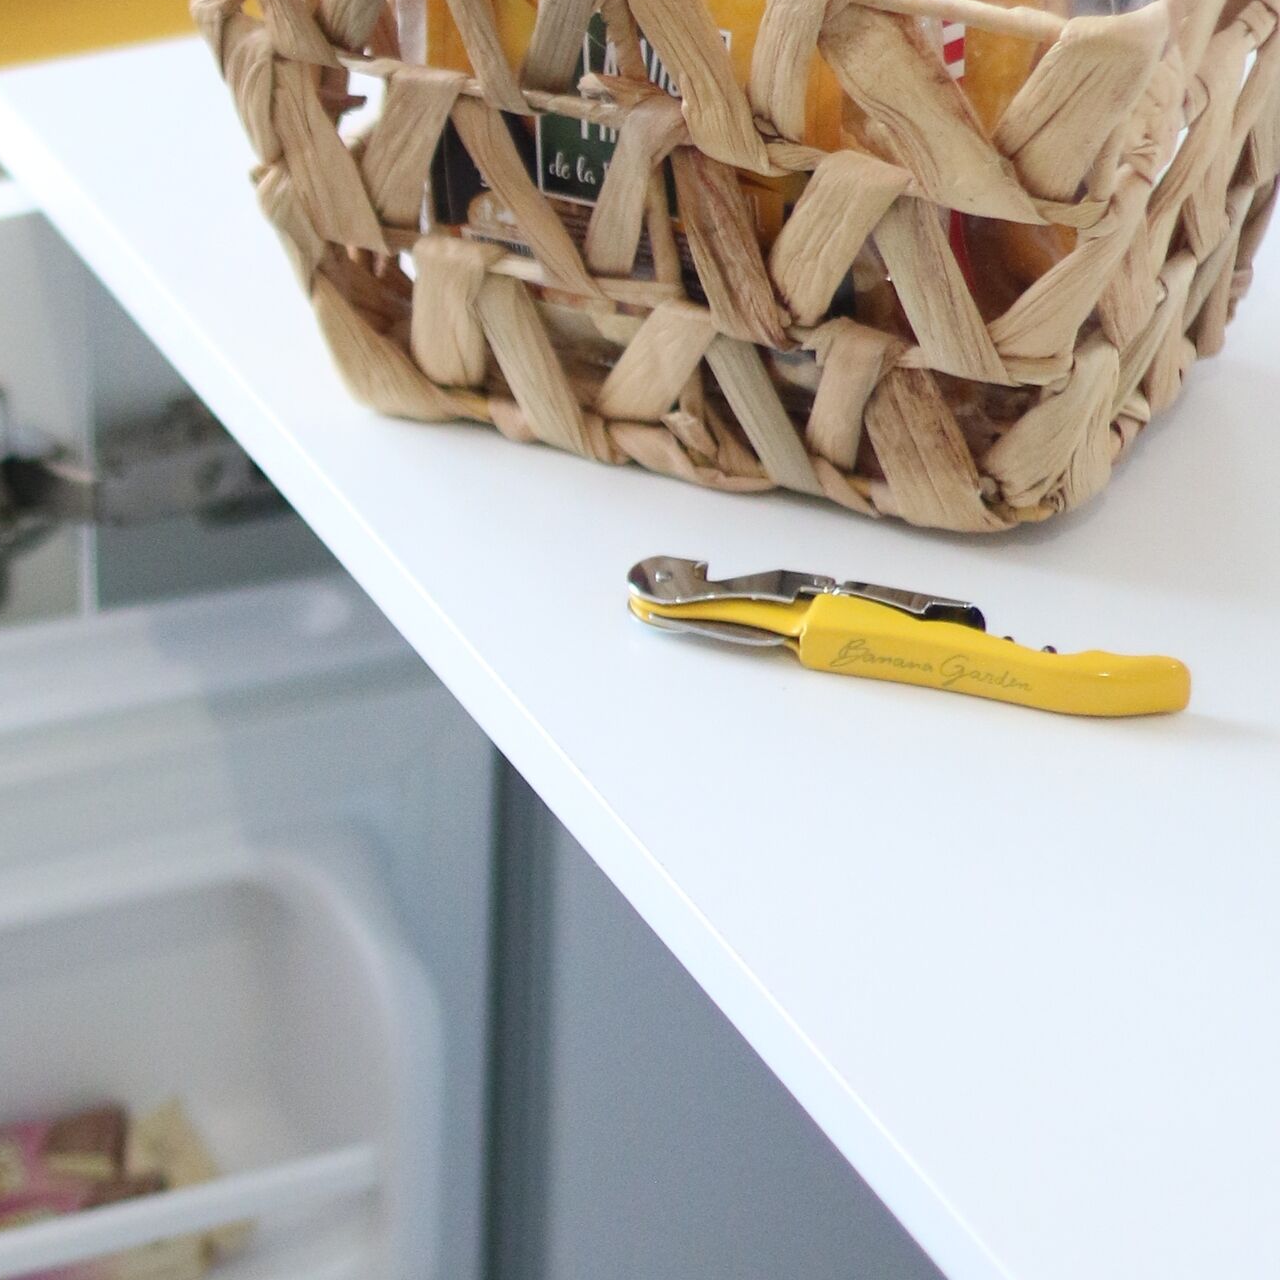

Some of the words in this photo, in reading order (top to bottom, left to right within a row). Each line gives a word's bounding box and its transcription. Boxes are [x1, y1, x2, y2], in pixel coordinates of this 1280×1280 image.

[549, 151, 571, 179] de
[576, 155, 596, 185] la
[830, 638, 933, 672] Banana
[939, 654, 1032, 692] Garden
